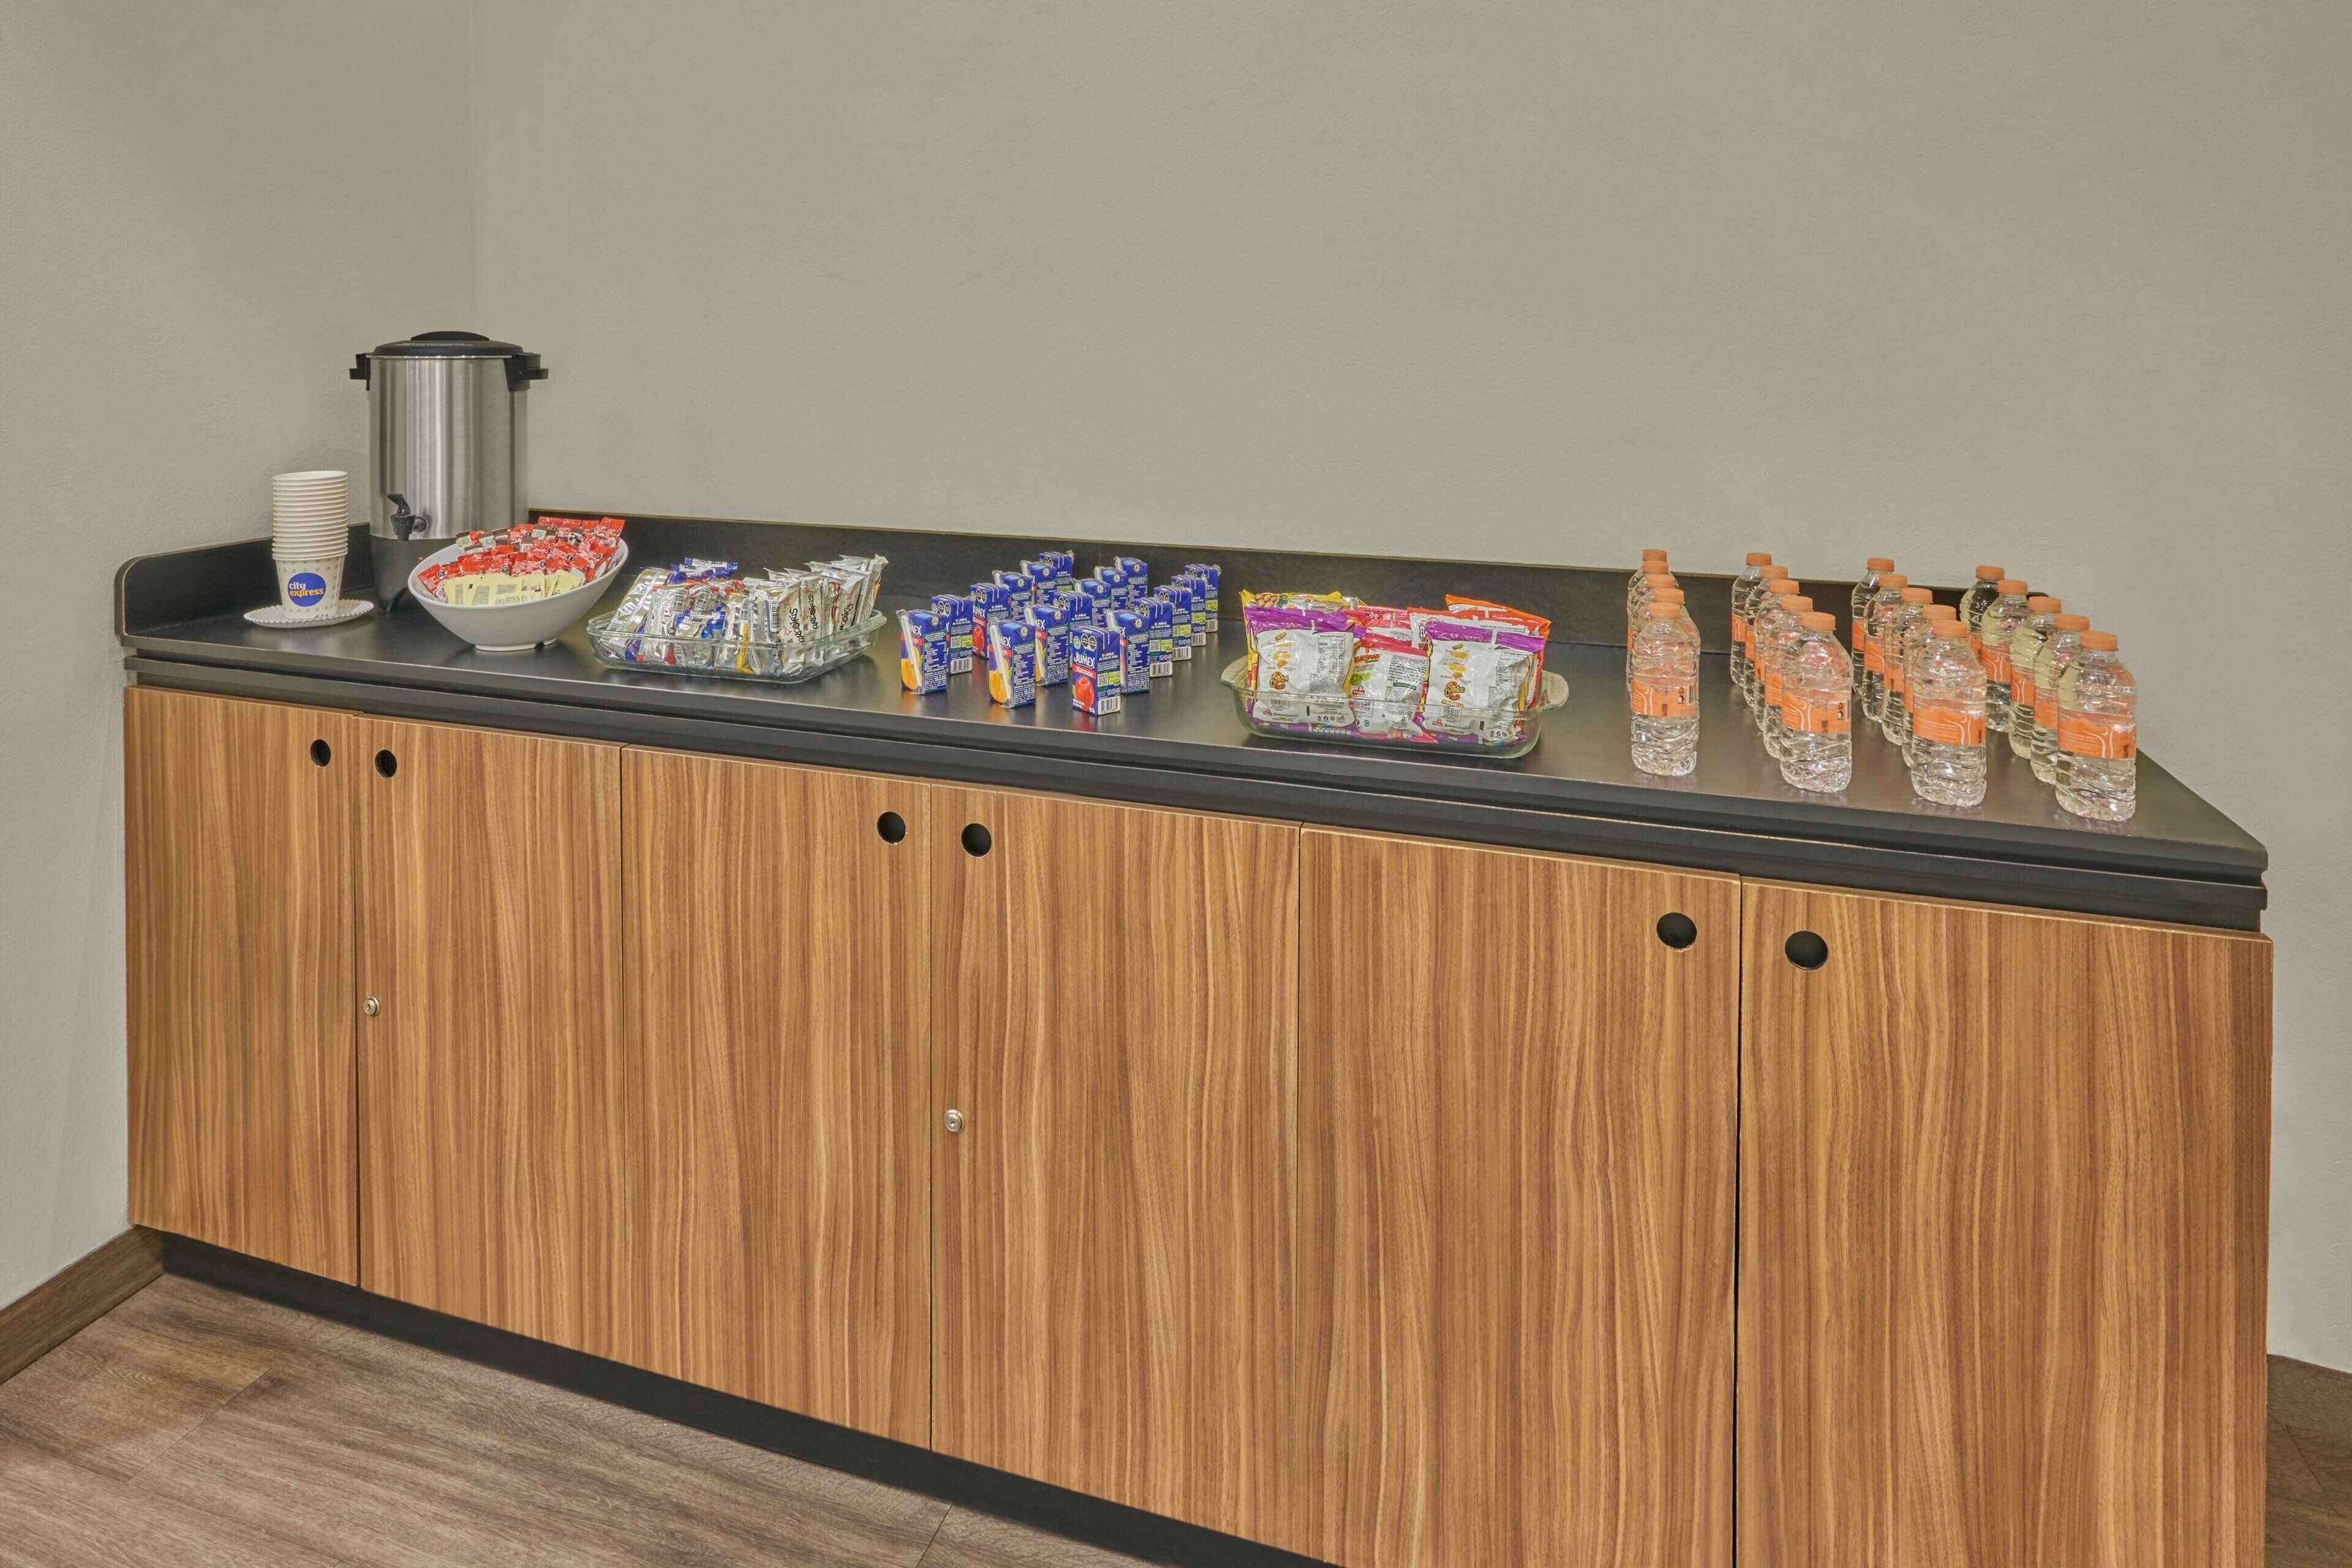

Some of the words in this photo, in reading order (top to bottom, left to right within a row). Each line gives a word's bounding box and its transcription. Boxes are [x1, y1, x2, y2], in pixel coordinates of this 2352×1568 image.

[290, 589, 323, 597] express
[1074, 652, 1095, 669] JUMEX
[1270, 675, 1289, 688] Cheetos
[1444, 685, 1465, 698] Cheetos
